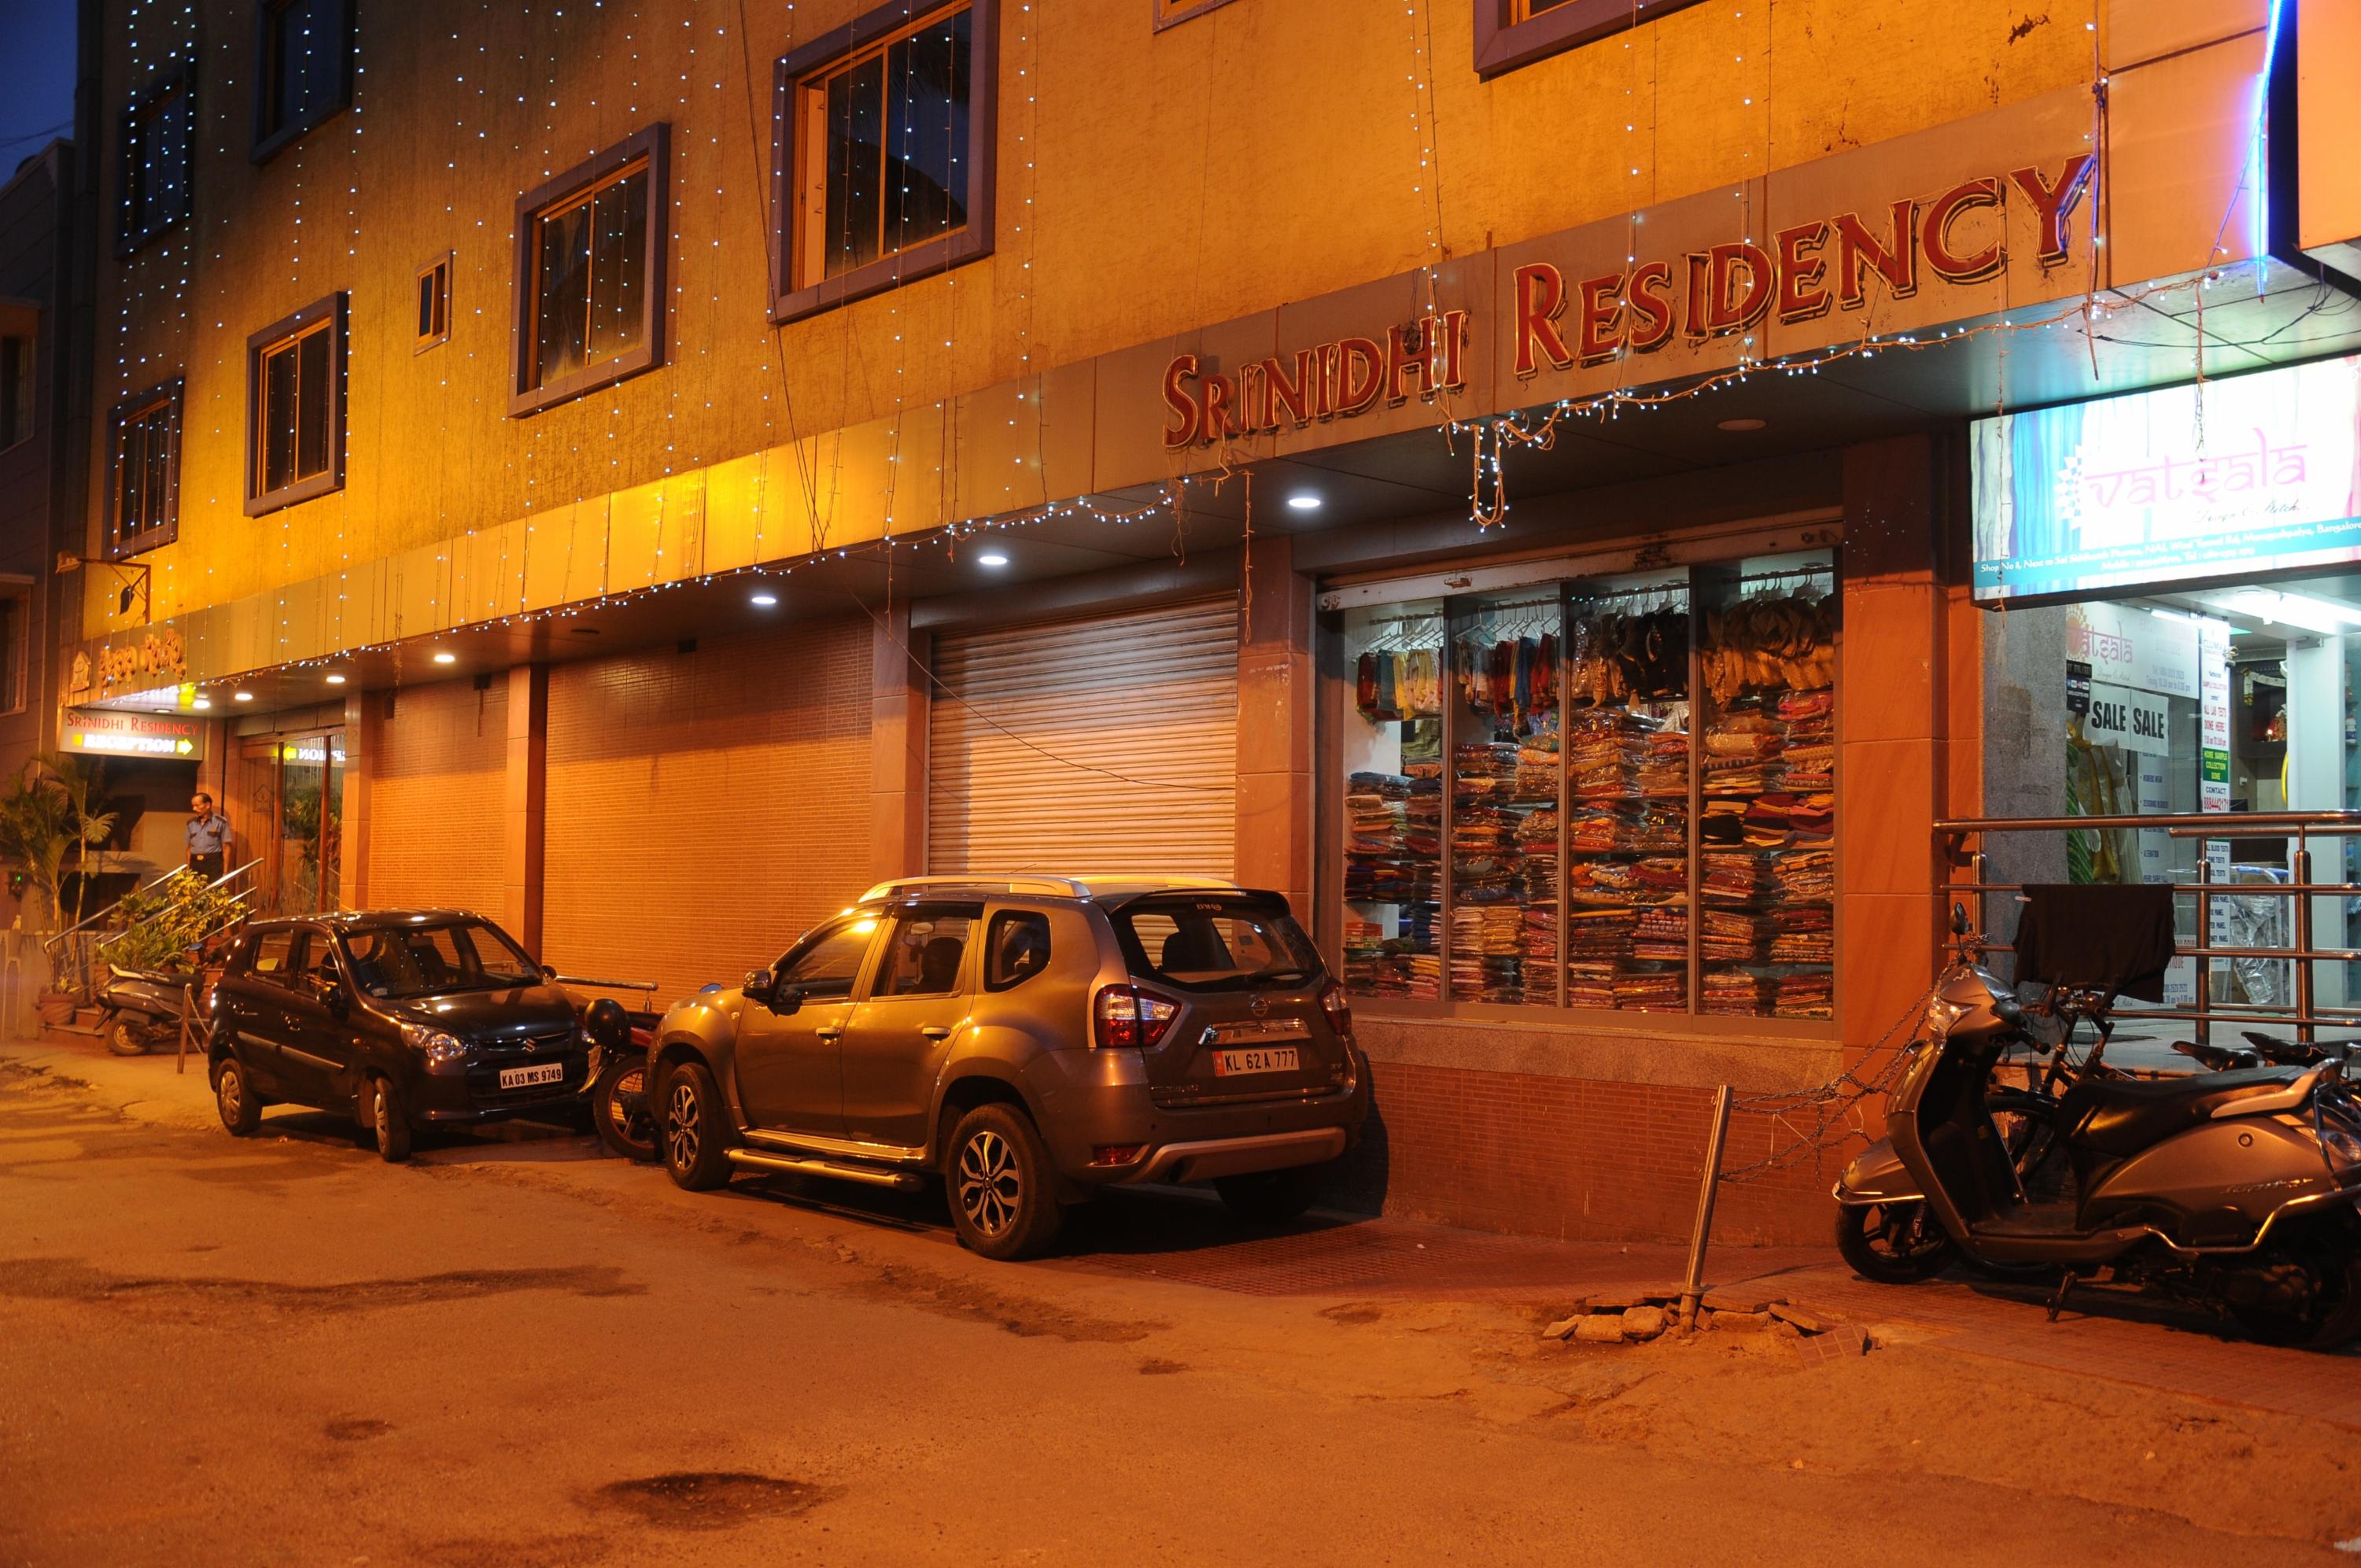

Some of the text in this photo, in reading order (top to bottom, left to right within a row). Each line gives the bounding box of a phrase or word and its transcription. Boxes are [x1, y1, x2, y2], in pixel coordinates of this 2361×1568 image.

[1162, 153, 2094, 448] SRINIDHI RESIDENCY
[1980, 563, 1999, 573] Shop
[2001, 562, 2013, 570] No
[68, 713, 199, 736] SRINIDHI RESIDENCY
[2091, 701, 2127, 732] SALE
[2133, 708, 2164, 739] SALE
[83, 733, 175, 753] RECEPTION
[1225, 1055, 1241, 1072] KL
[1275, 1050, 1295, 1067] 777
[502, 1068, 562, 1087] KA 03 MS 9749
